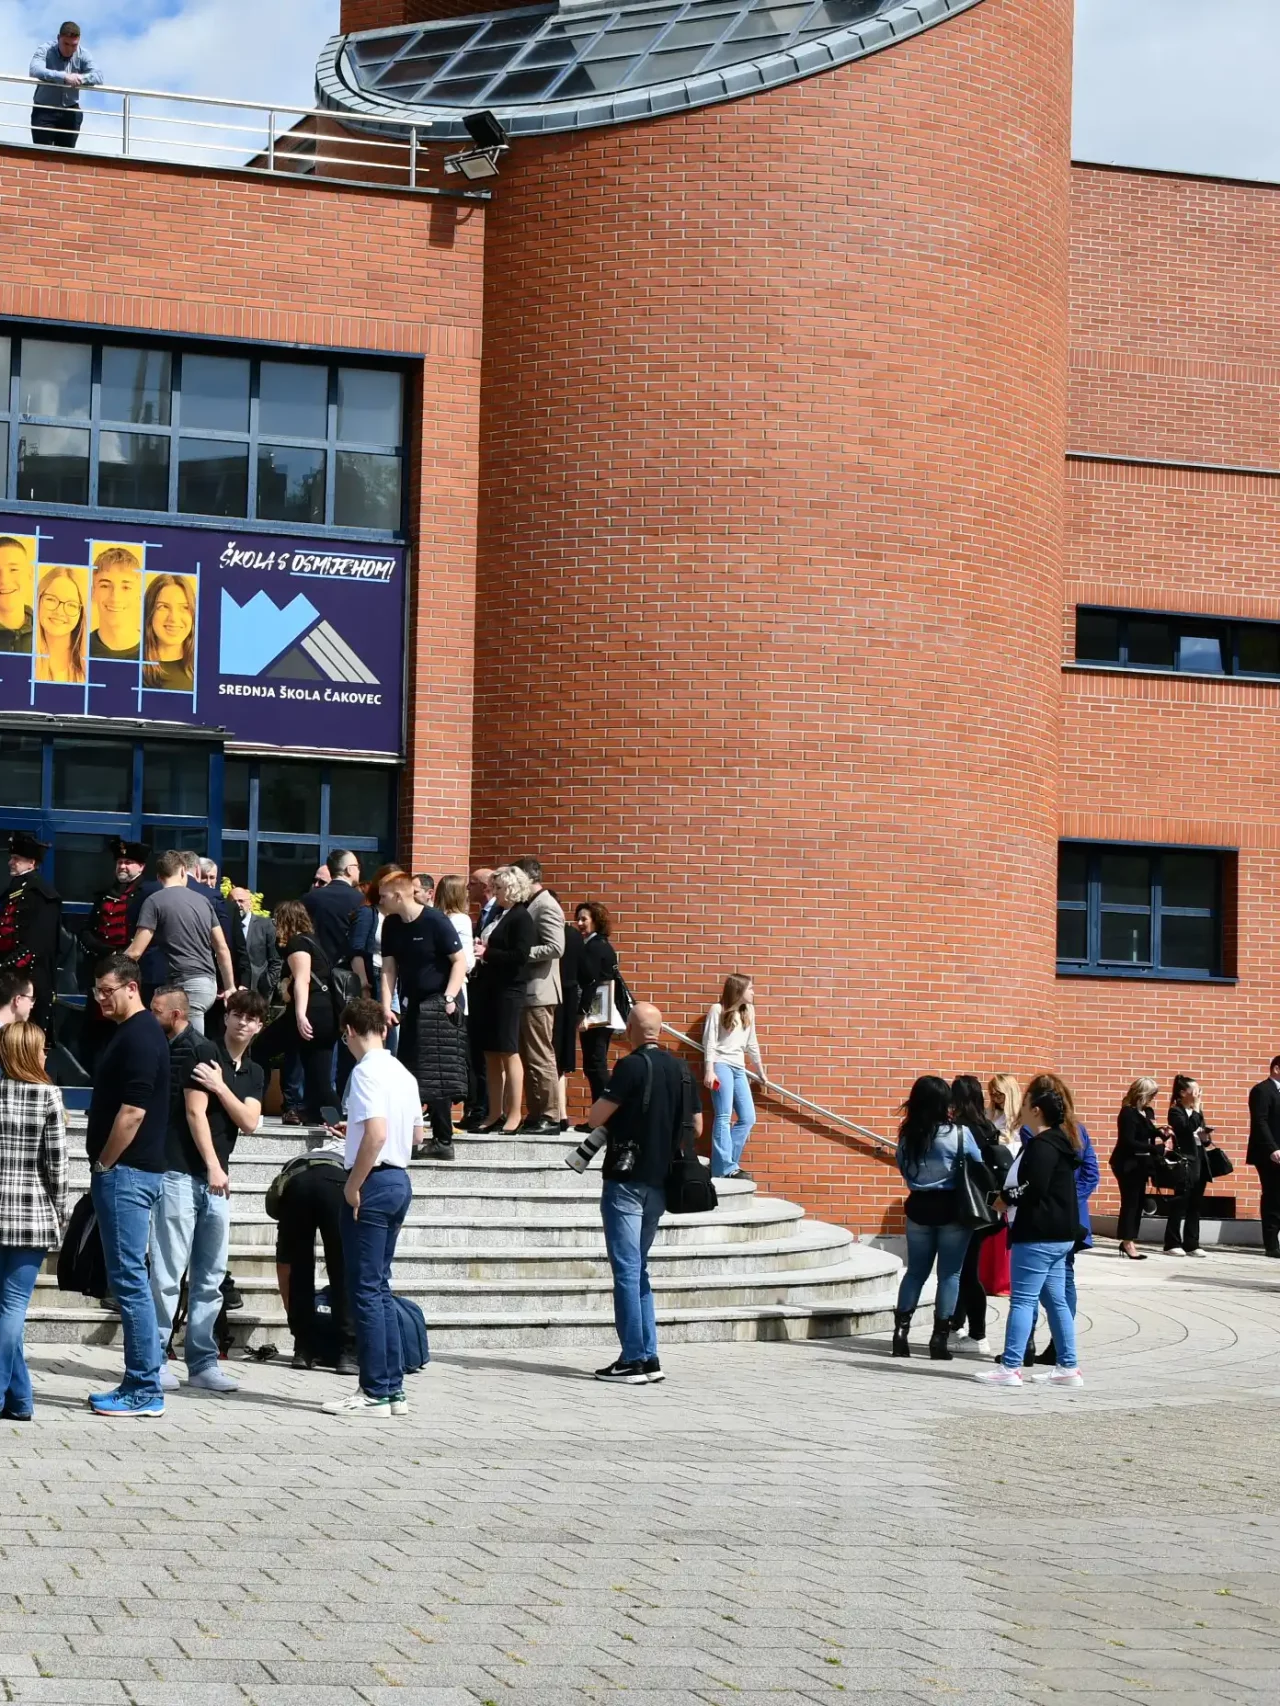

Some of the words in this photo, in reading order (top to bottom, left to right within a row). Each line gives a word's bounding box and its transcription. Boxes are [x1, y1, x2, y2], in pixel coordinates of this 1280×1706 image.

[219, 541, 276, 570] ŠKOLA
[277, 552, 291, 571] S
[291, 555, 396, 580] OSMIJEHOM!
[218, 684, 276, 699] SREDNJA
[279, 685, 320, 701] ŠKOLA
[323, 688, 382, 705] ČAKOVEC
